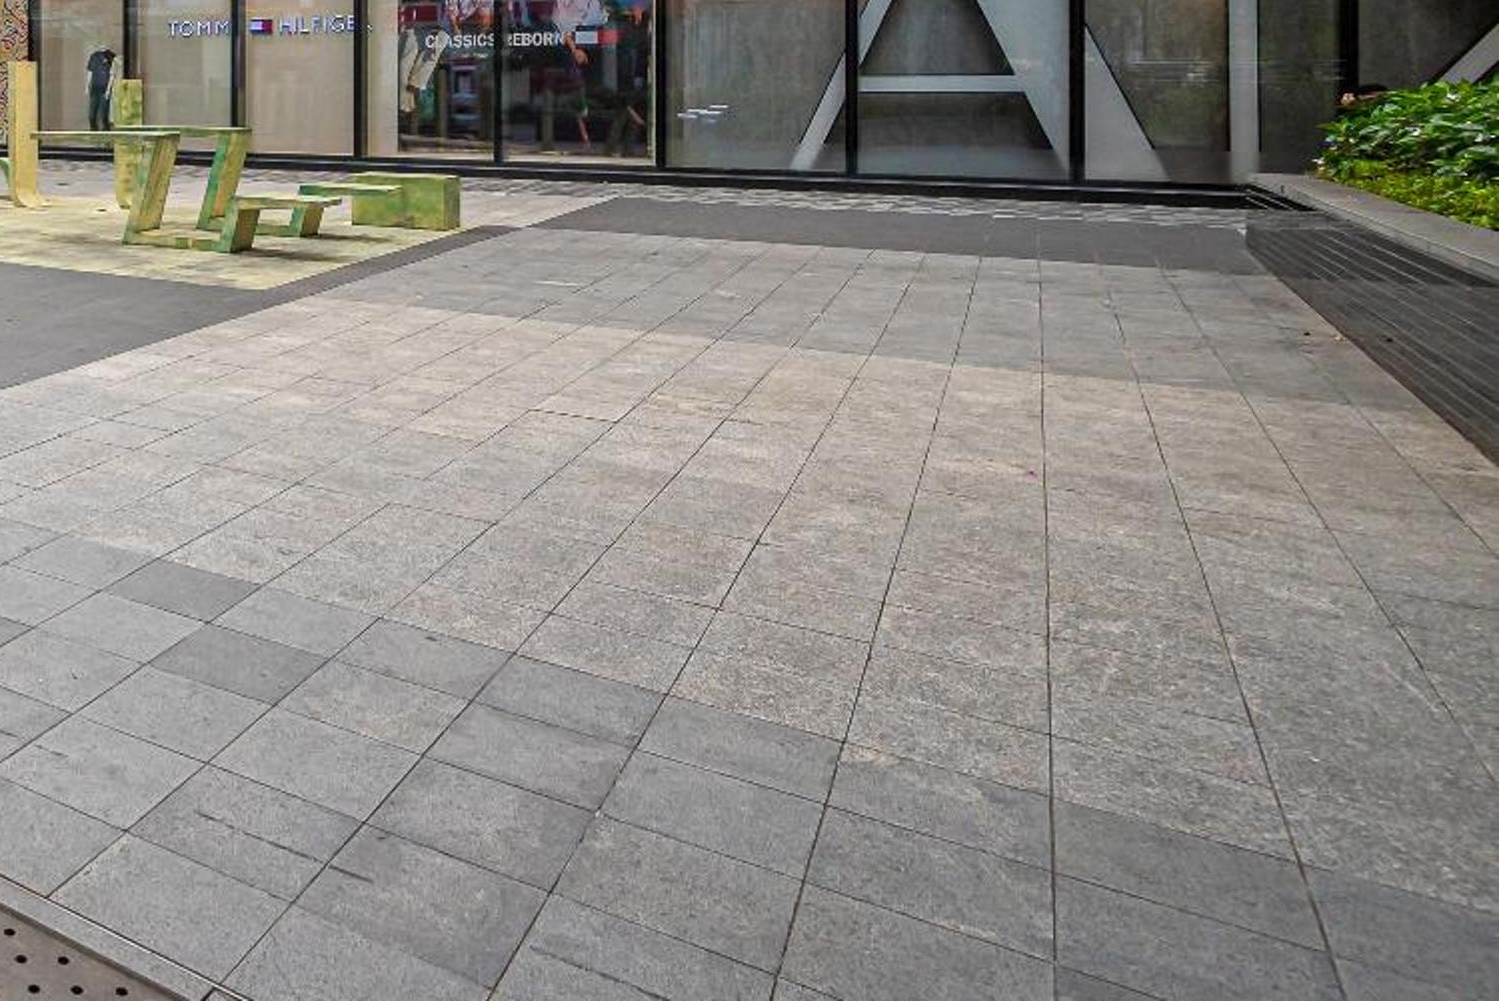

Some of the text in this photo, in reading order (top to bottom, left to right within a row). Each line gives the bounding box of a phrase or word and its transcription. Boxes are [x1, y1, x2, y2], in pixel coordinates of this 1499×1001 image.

[168, 14, 372, 38] TOMM HILFIGE
[425, 32, 494, 48] CSSICS
